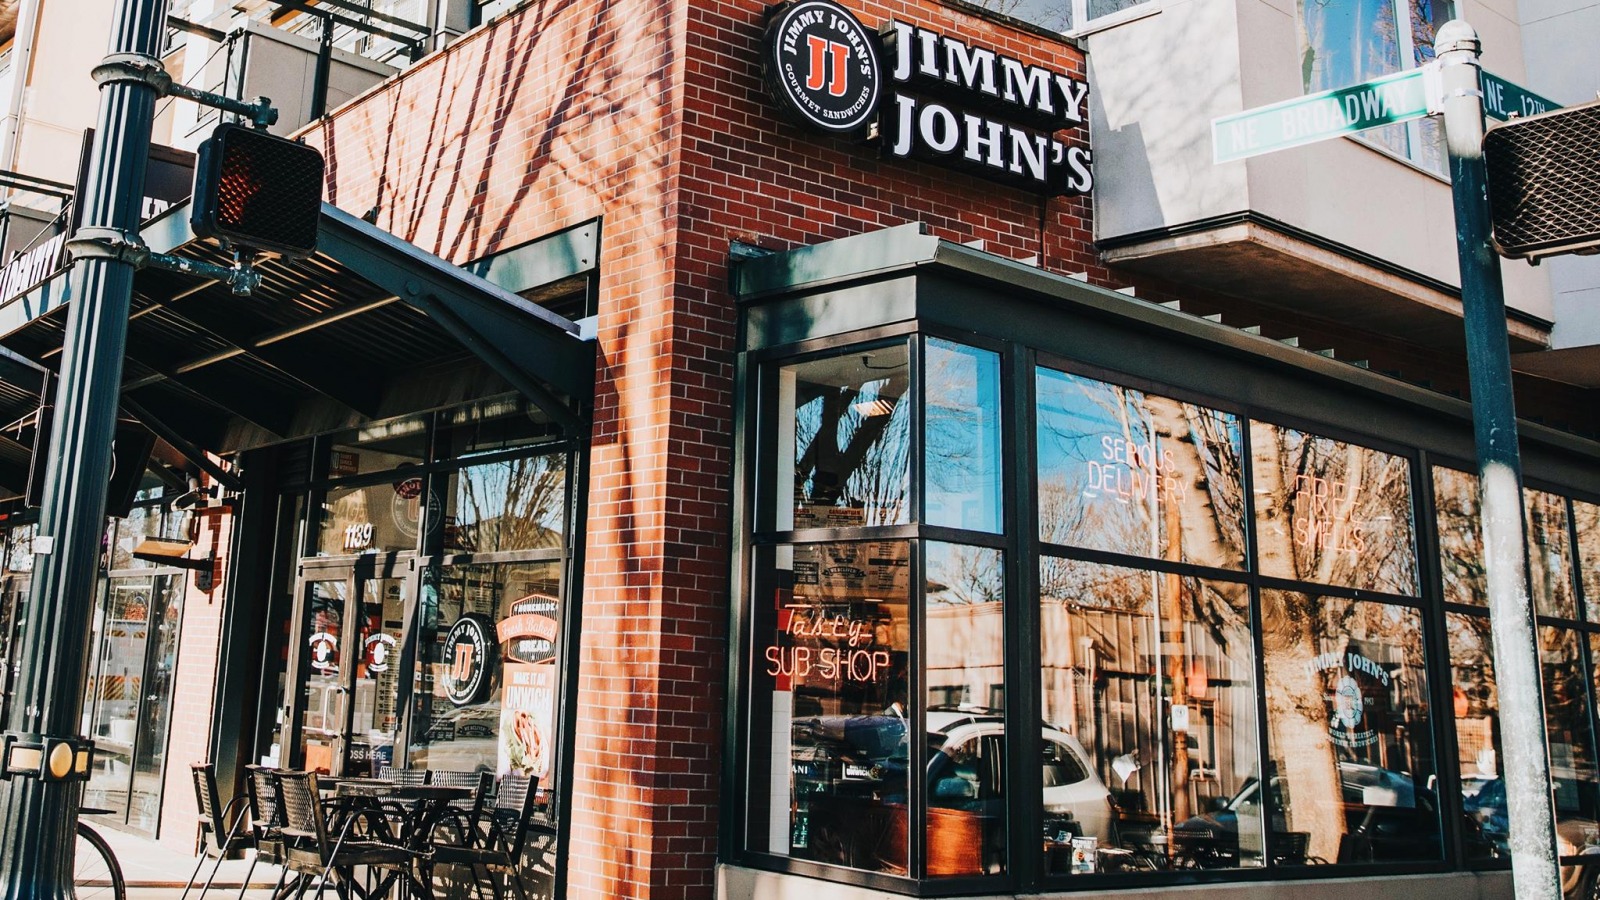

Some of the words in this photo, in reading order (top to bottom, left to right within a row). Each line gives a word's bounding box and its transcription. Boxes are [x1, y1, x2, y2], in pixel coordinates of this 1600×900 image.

[784, 10, 824, 55] JIMMY
[829, 14, 872, 77] JOHN'S
[806, 33, 850, 97] JJ
[893, 21, 1088, 123] JIMMY
[785, 63, 821, 113] GOURMET
[823, 85, 870, 119] SANDWICHES
[1486, 78, 1506, 116] NE
[1520, 94, 1546, 118] 12TH
[1230, 117, 1260, 153] NE
[1282, 80, 1412, 141] BROADWAY
[893, 93, 1093, 193] JOHN'S
[1101, 435, 1175, 474] SERIOUS
[1088, 460, 1191, 505] DELIVERY
[1295, 475, 1364, 523] FREE
[344, 522, 373, 549] 1139
[1296, 517, 1366, 554] SMELLS
[445, 624, 466, 660] JIMMY
[527, 617, 555, 638] Baked
[784, 603, 873, 647] Tasty
[452, 642, 474, 682] JJ
[519, 640, 551, 653] BREAD
[765, 646, 810, 677] SUB
[820, 648, 890, 682] SHOP
[513, 671, 530, 685] MAKE
[530, 672, 537, 686] IT
[1304, 652, 1344, 684] JIMMY
[1347, 652, 1389, 687] JOHN'S
[506, 685, 553, 709] UNWICH
[365, 751, 387, 760] HERE
